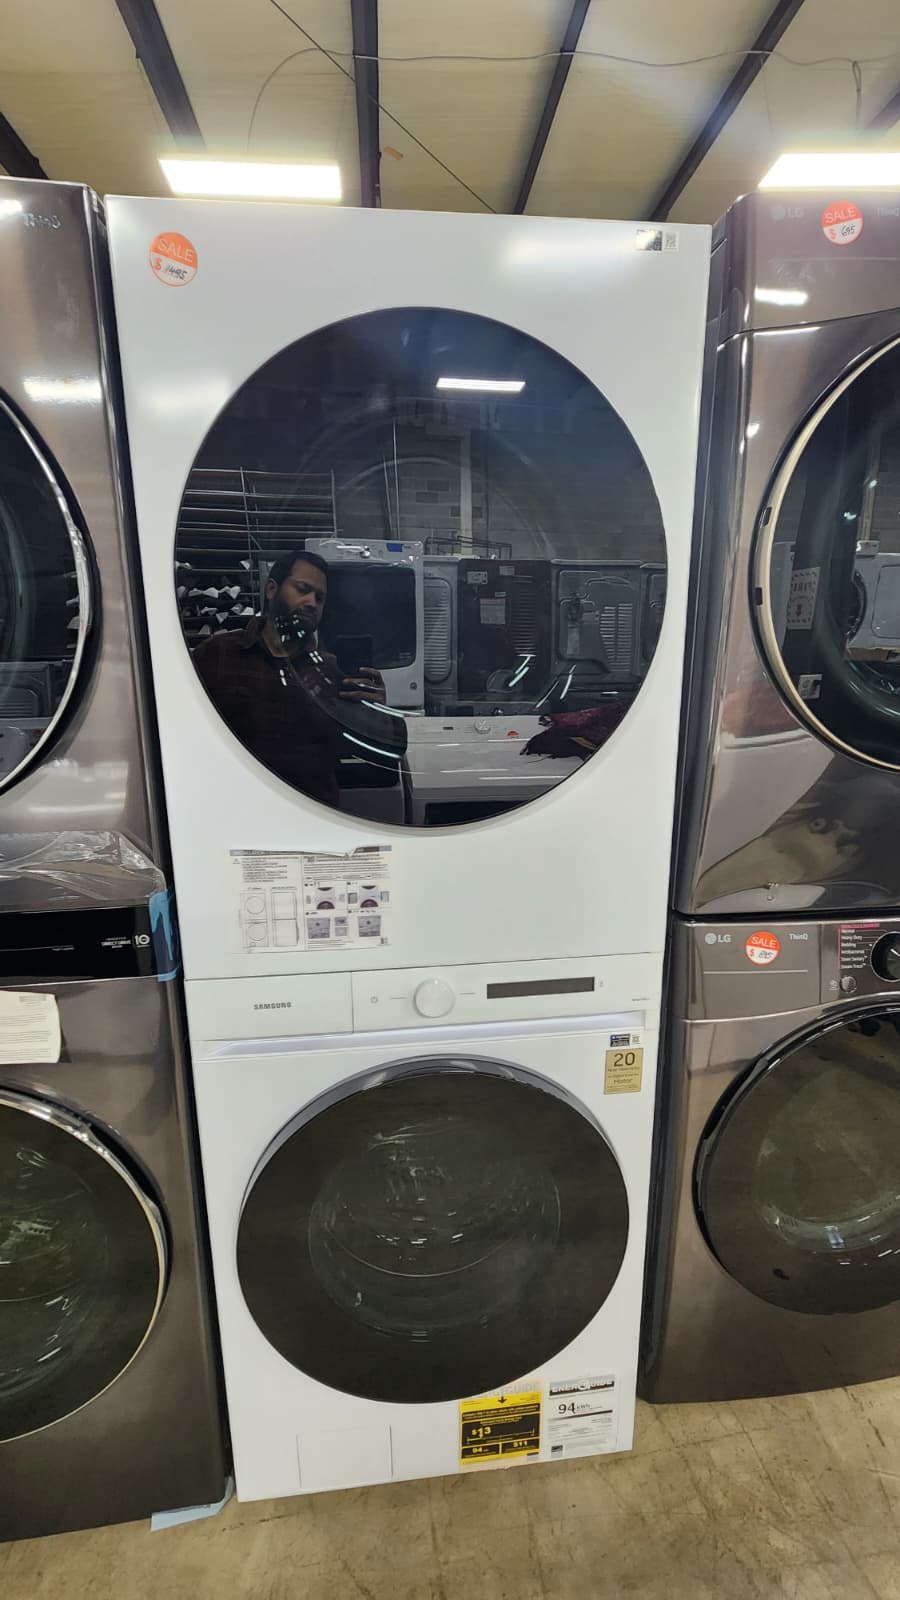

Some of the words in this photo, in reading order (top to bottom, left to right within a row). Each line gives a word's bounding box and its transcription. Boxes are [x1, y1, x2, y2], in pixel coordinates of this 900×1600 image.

[825, 207, 857, 224] SALE
[158, 238, 193, 263] SALE
[717, 934, 731, 943] LG
[751, 936, 777, 949] SALE
[789, 933, 808, 941] ThinQ
[253, 1002, 292, 1010] SAMSUNG
[614, 1052, 635, 1067] 20
[558, 1402, 576, 1415] 94
